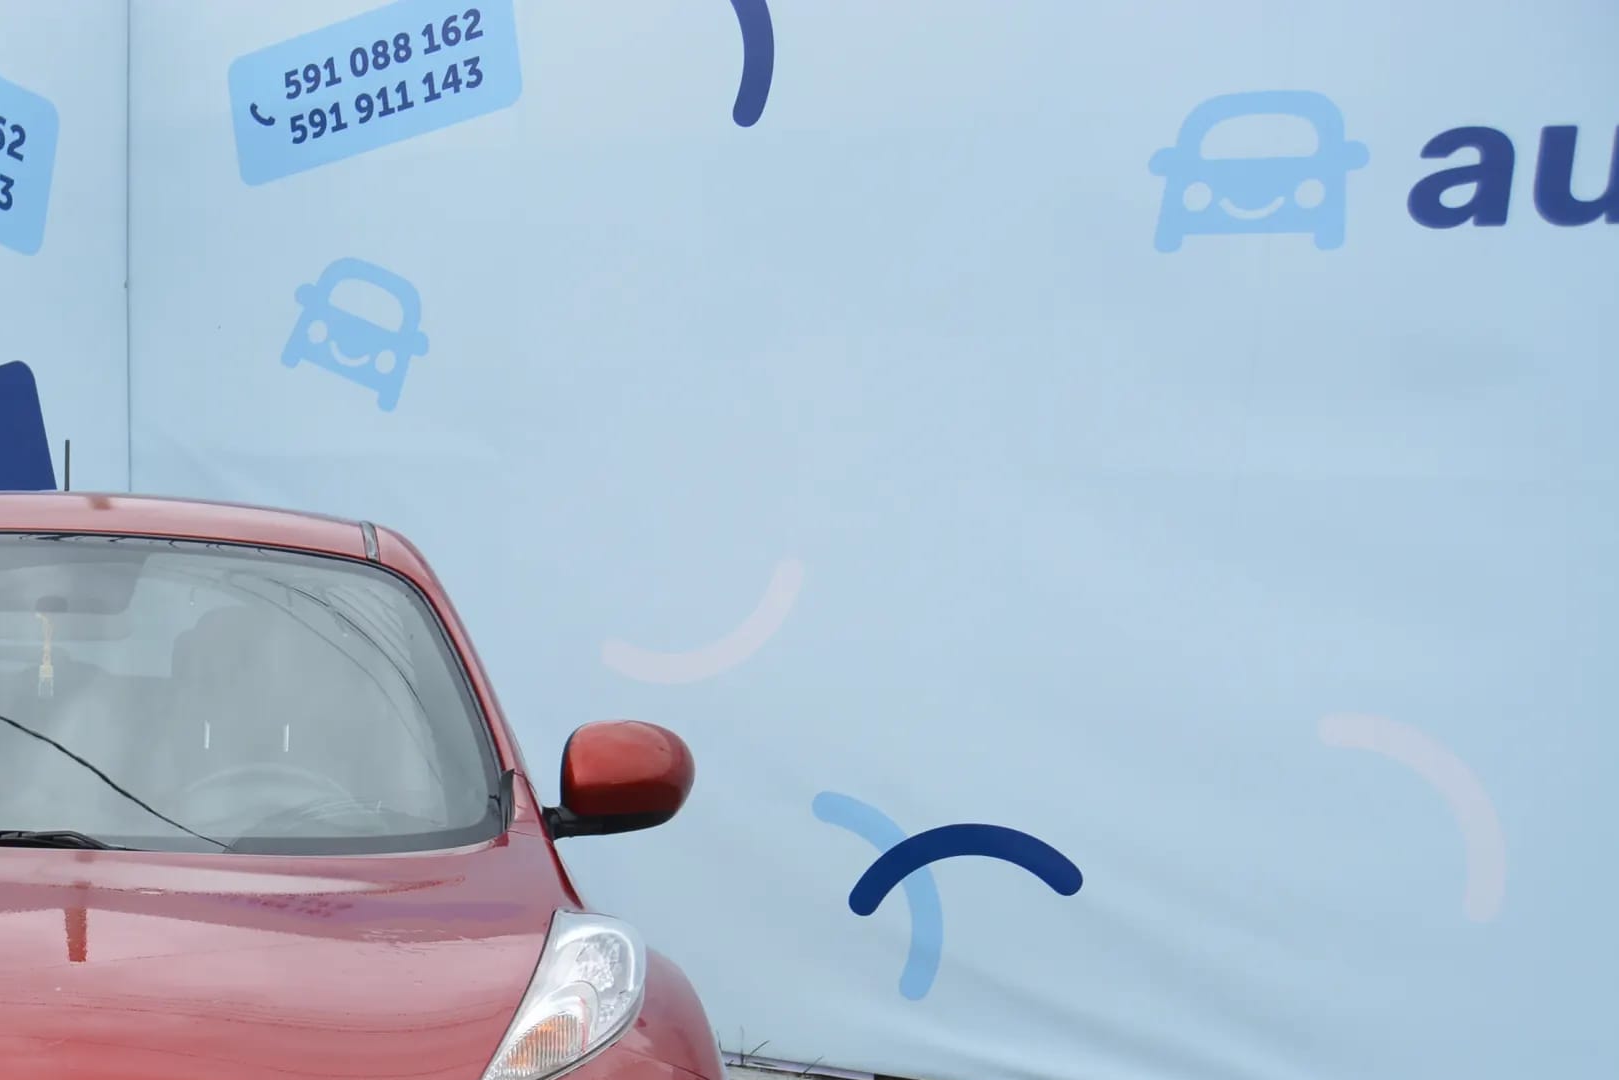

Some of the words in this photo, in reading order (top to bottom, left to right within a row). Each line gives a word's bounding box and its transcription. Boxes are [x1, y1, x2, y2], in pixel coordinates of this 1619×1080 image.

[284, 56, 343, 100] 591
[349, 32, 413, 78] 088
[421, 8, 484, 56] 162
[289, 101, 349, 145] 591
[354, 79, 415, 125] 911
[421, 55, 484, 104] 143
[1407, 124, 1619, 229] au
